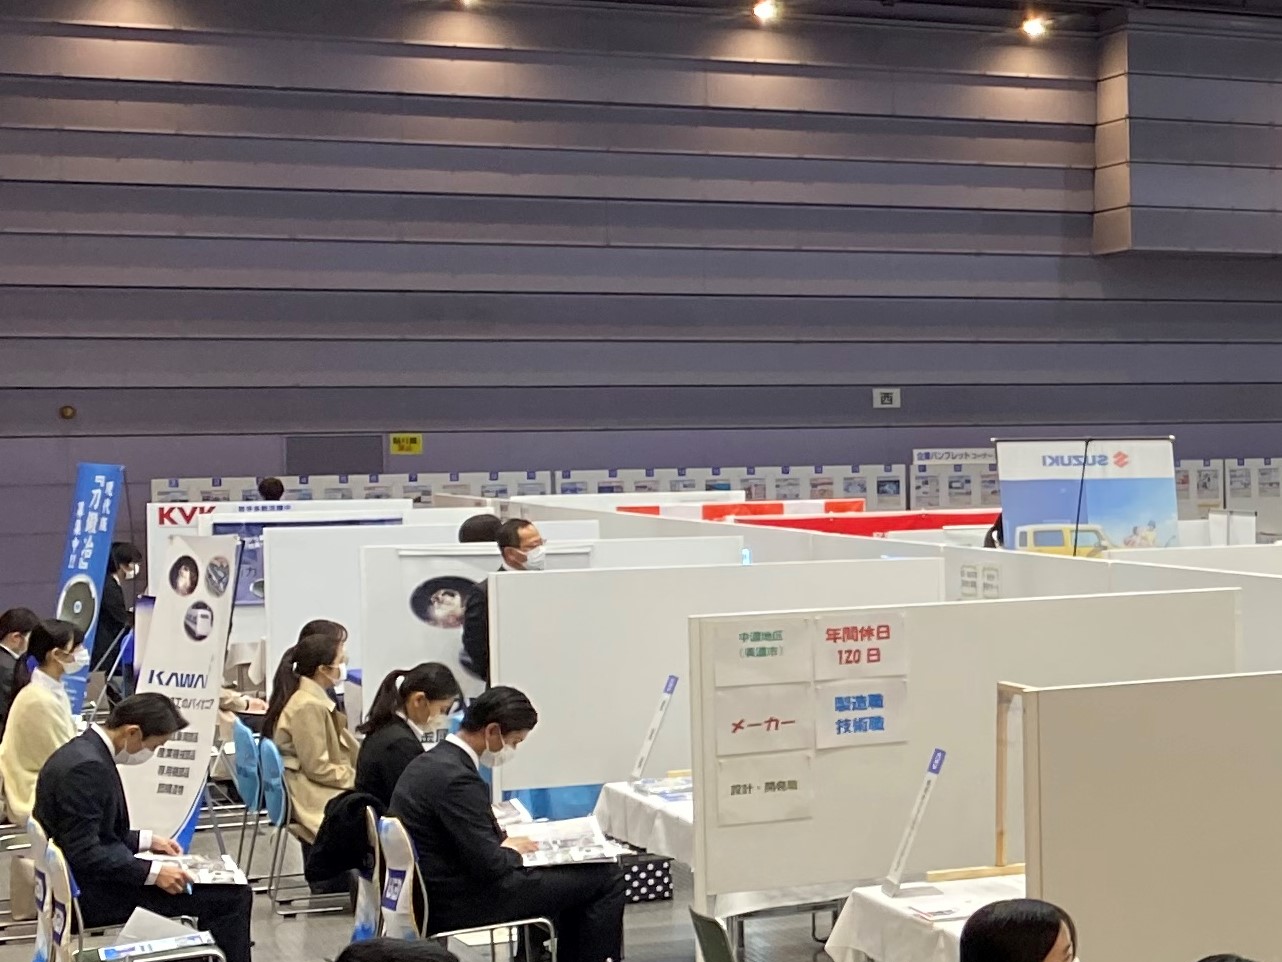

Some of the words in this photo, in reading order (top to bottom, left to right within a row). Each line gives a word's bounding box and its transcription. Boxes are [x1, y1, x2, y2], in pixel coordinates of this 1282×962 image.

[880, 392, 893, 405] 西
[825, 624, 891, 643] 年間休日
[731, 717, 796, 734] メーカー
